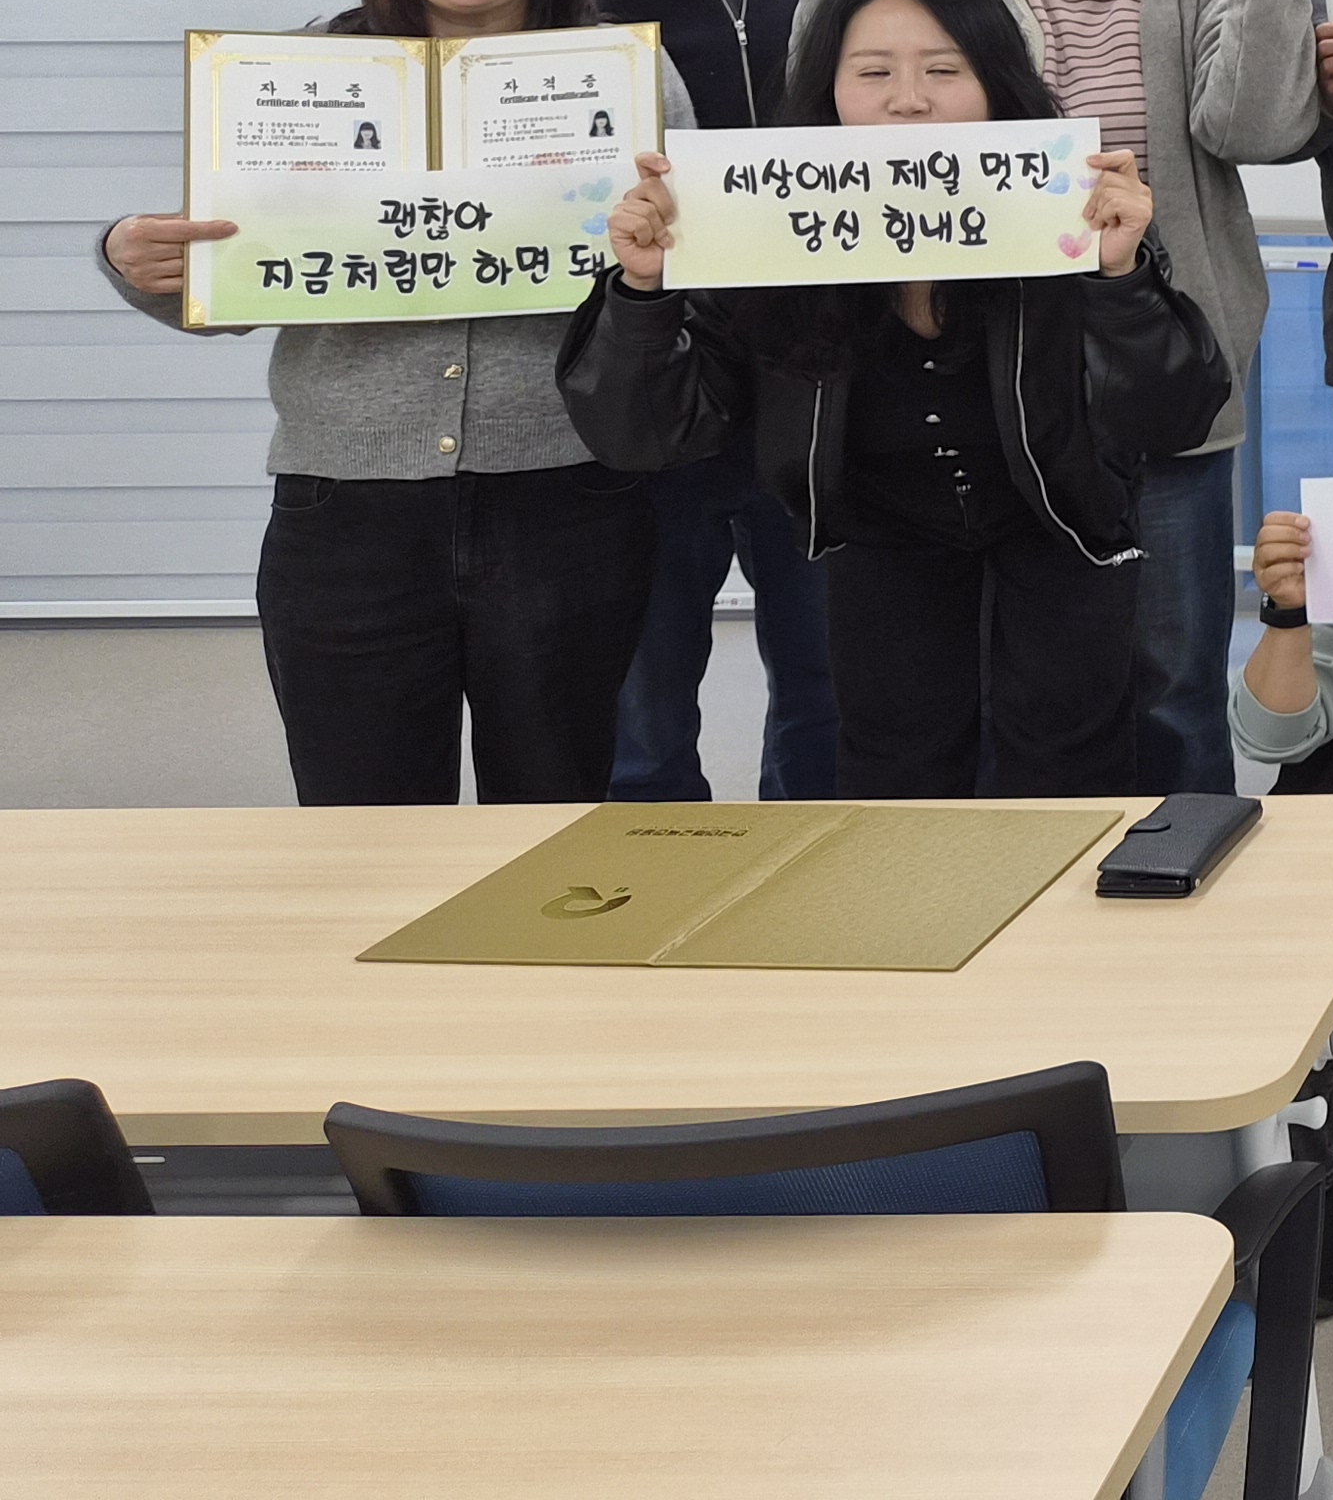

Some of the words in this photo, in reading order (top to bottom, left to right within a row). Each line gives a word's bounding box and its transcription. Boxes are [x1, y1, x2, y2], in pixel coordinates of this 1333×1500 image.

[723, 157, 871, 200] 세상에서
[885, 150, 960, 197] 제일
[979, 150, 1050, 192] 멋진
[377, 196, 494, 241] 괜찮아
[787, 209, 860, 253] 당신
[881, 203, 988, 254] 힘내요
[255, 249, 457, 295] 지금처럼만
[471, 245, 550, 286] 하면
[567, 244, 606, 278] 돼
